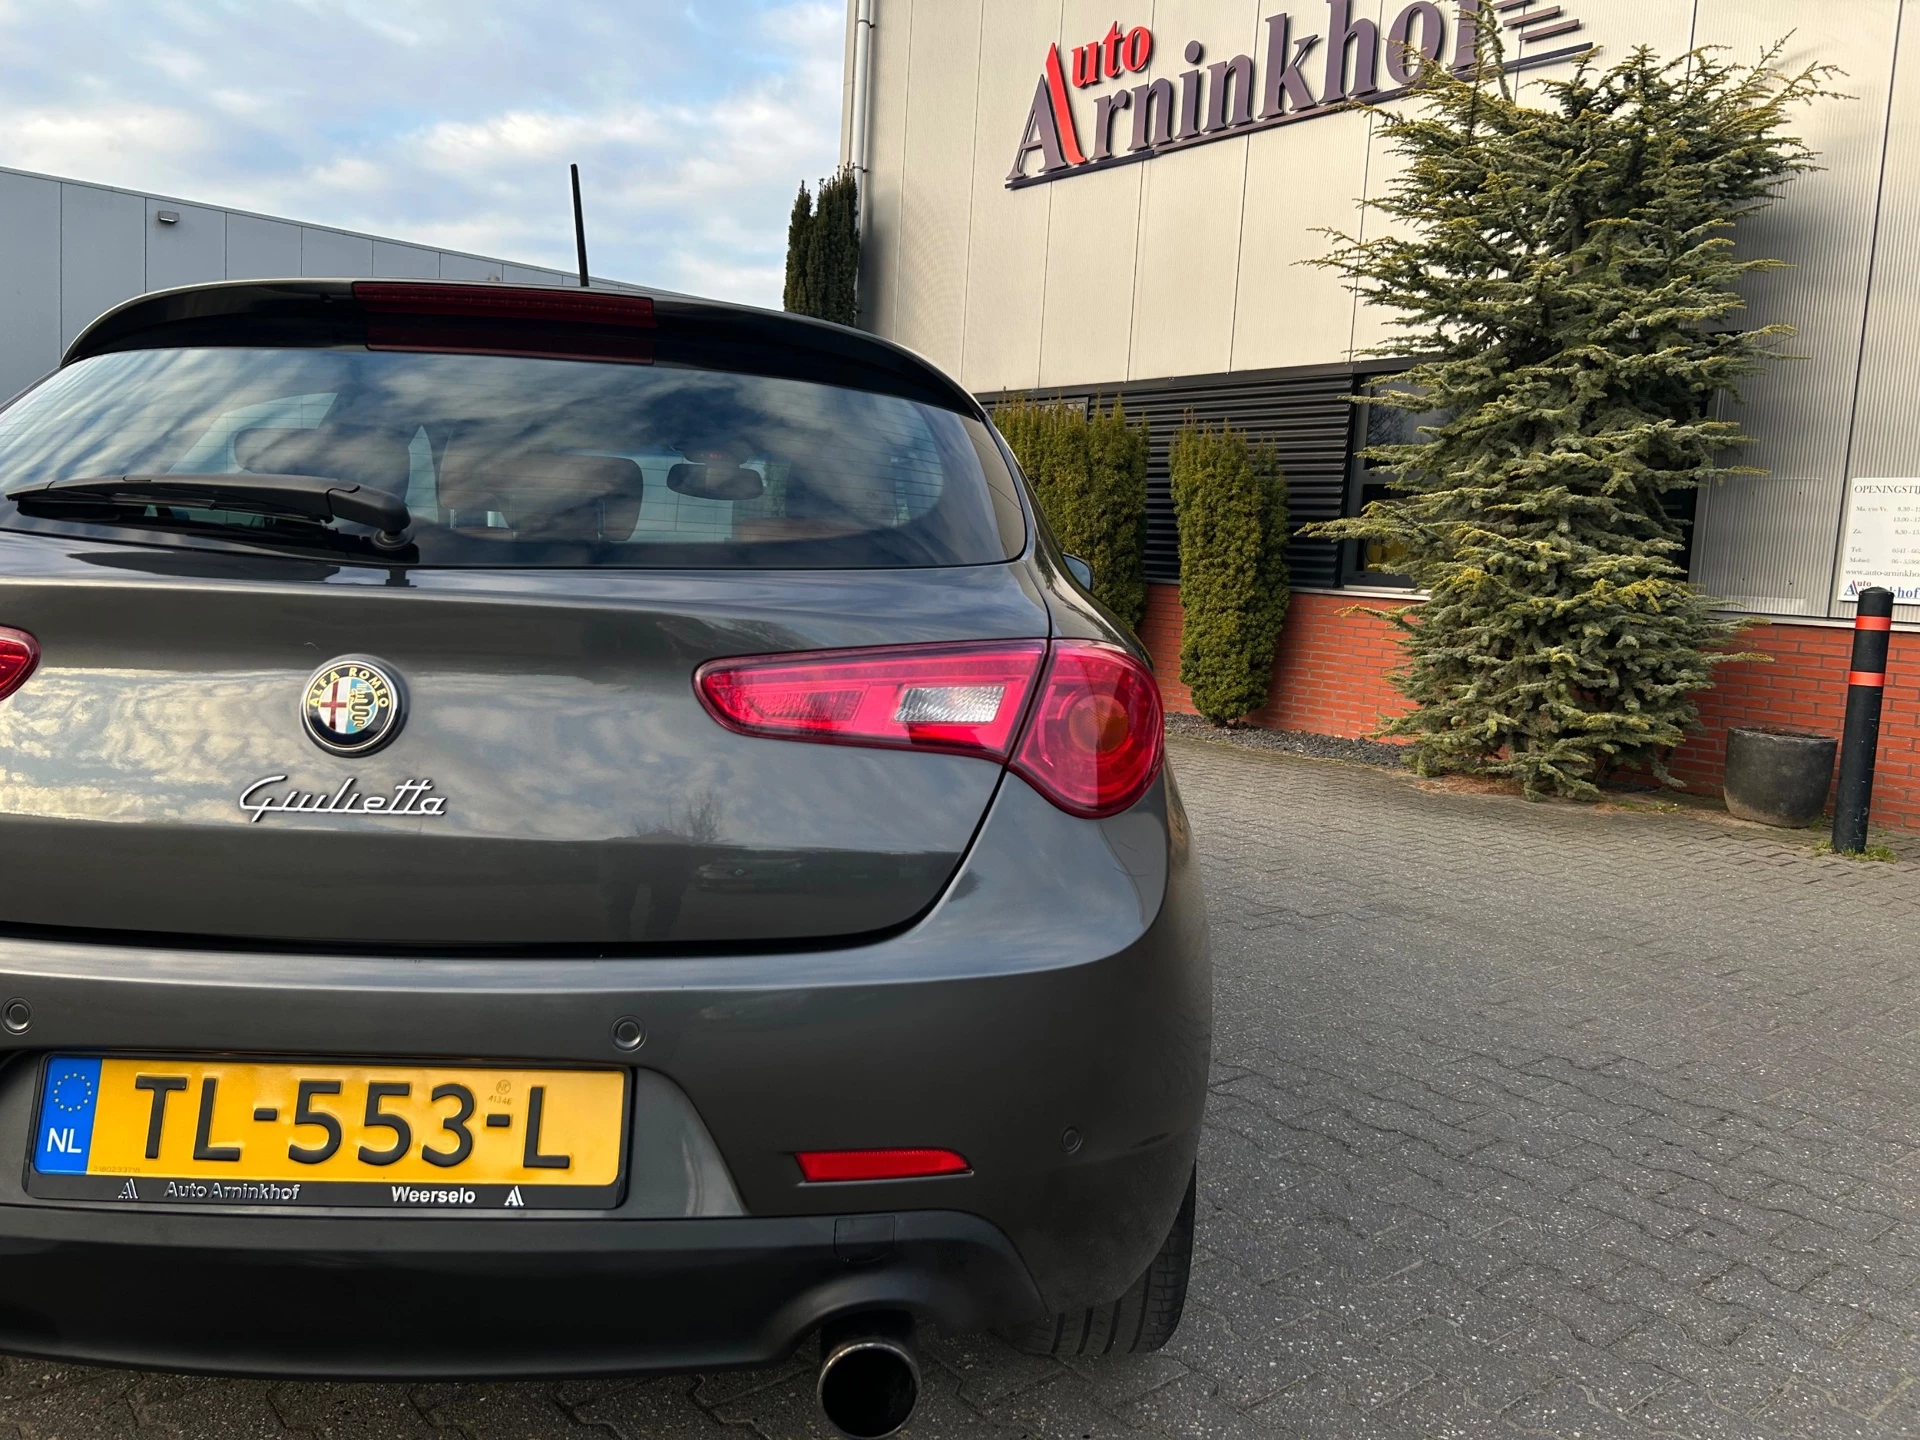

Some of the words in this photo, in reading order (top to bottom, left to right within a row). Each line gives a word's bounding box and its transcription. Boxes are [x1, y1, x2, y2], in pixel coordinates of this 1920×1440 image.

[309, 671, 340, 707] ALFA
[348, 667, 389, 708] ROMEO
[239, 774, 448, 824] Giulietta
[47, 1127, 82, 1154] NL
[135, 1074, 571, 1170] TL-553-L
[164, 1180, 207, 1198] Auto
[209, 1182, 301, 1200] Arninkhof
[391, 1186, 476, 1204] Weerselo
